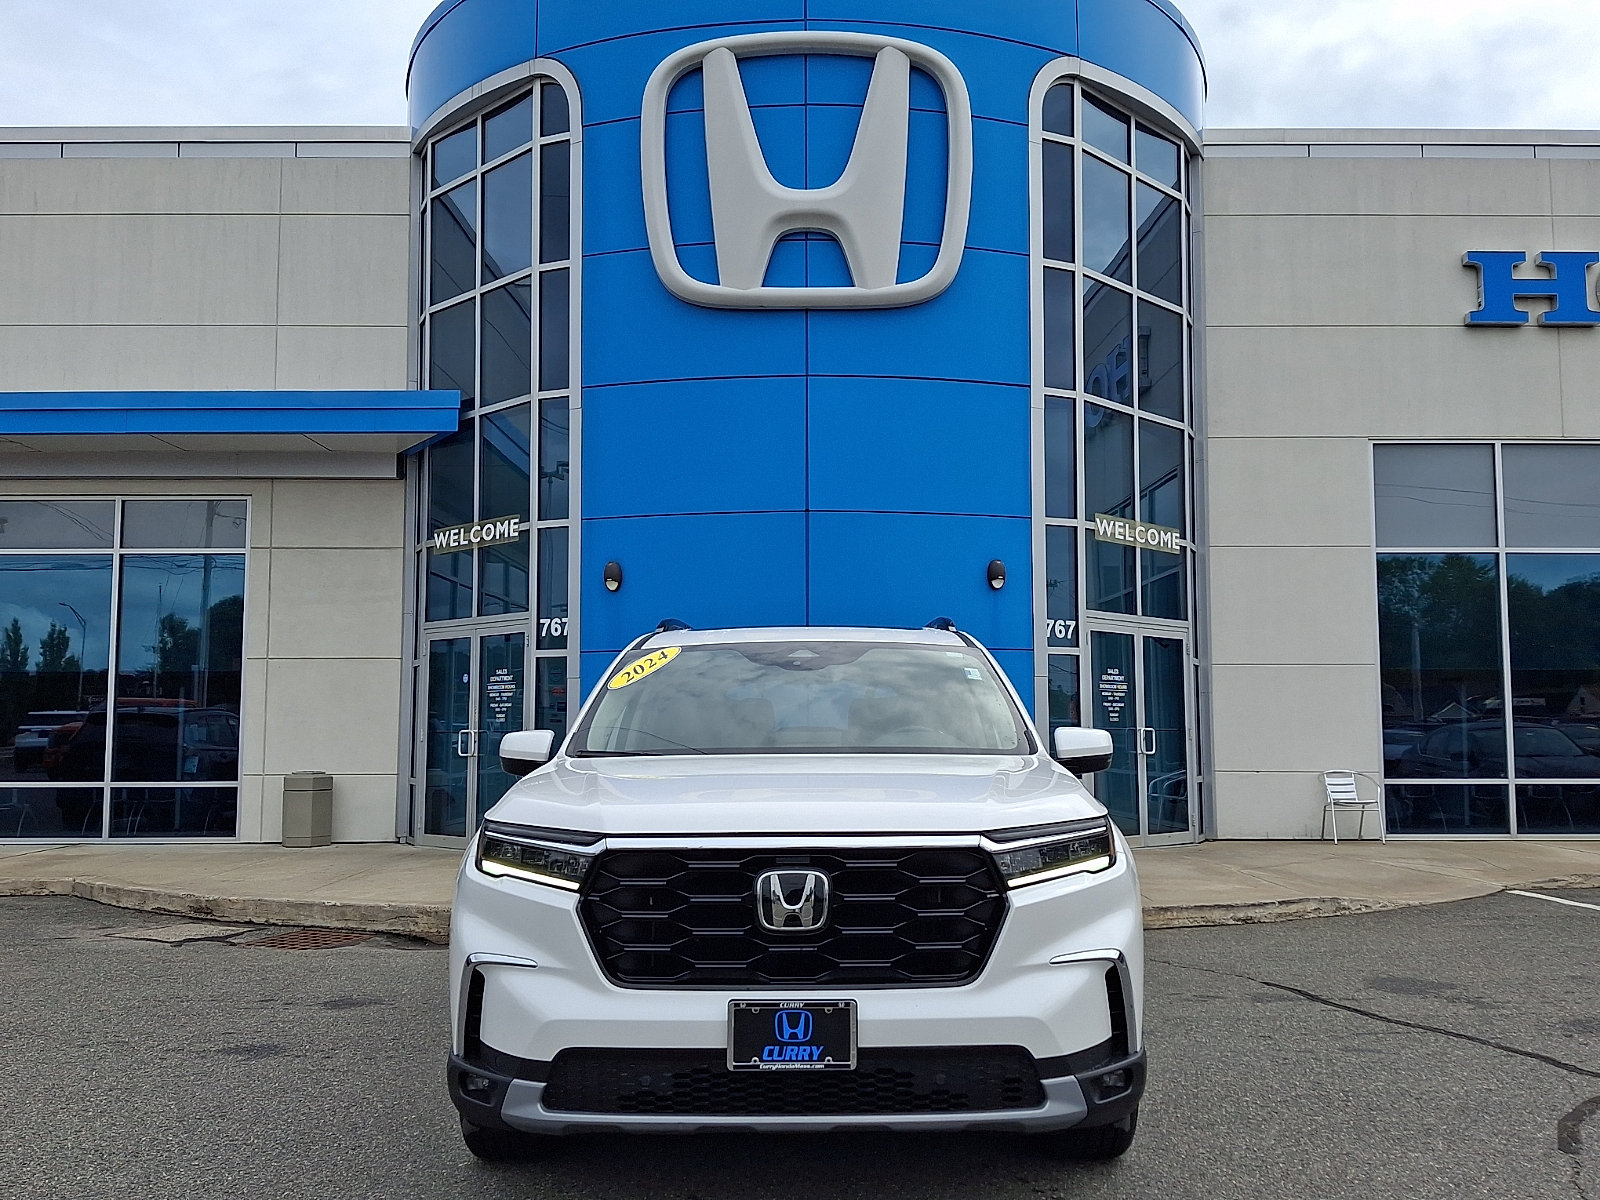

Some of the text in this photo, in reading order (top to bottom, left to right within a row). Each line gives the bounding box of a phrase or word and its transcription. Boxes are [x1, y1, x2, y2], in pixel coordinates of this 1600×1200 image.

[1462, 250, 1600, 326] H
[434, 517, 521, 549] WELCOME
[1095, 517, 1181, 550] WELCOME
[539, 617, 569, 637] 767
[1046, 619, 1076, 639] 767
[621, 650, 669, 683] 2024
[762, 1045, 824, 1061] CURRY
